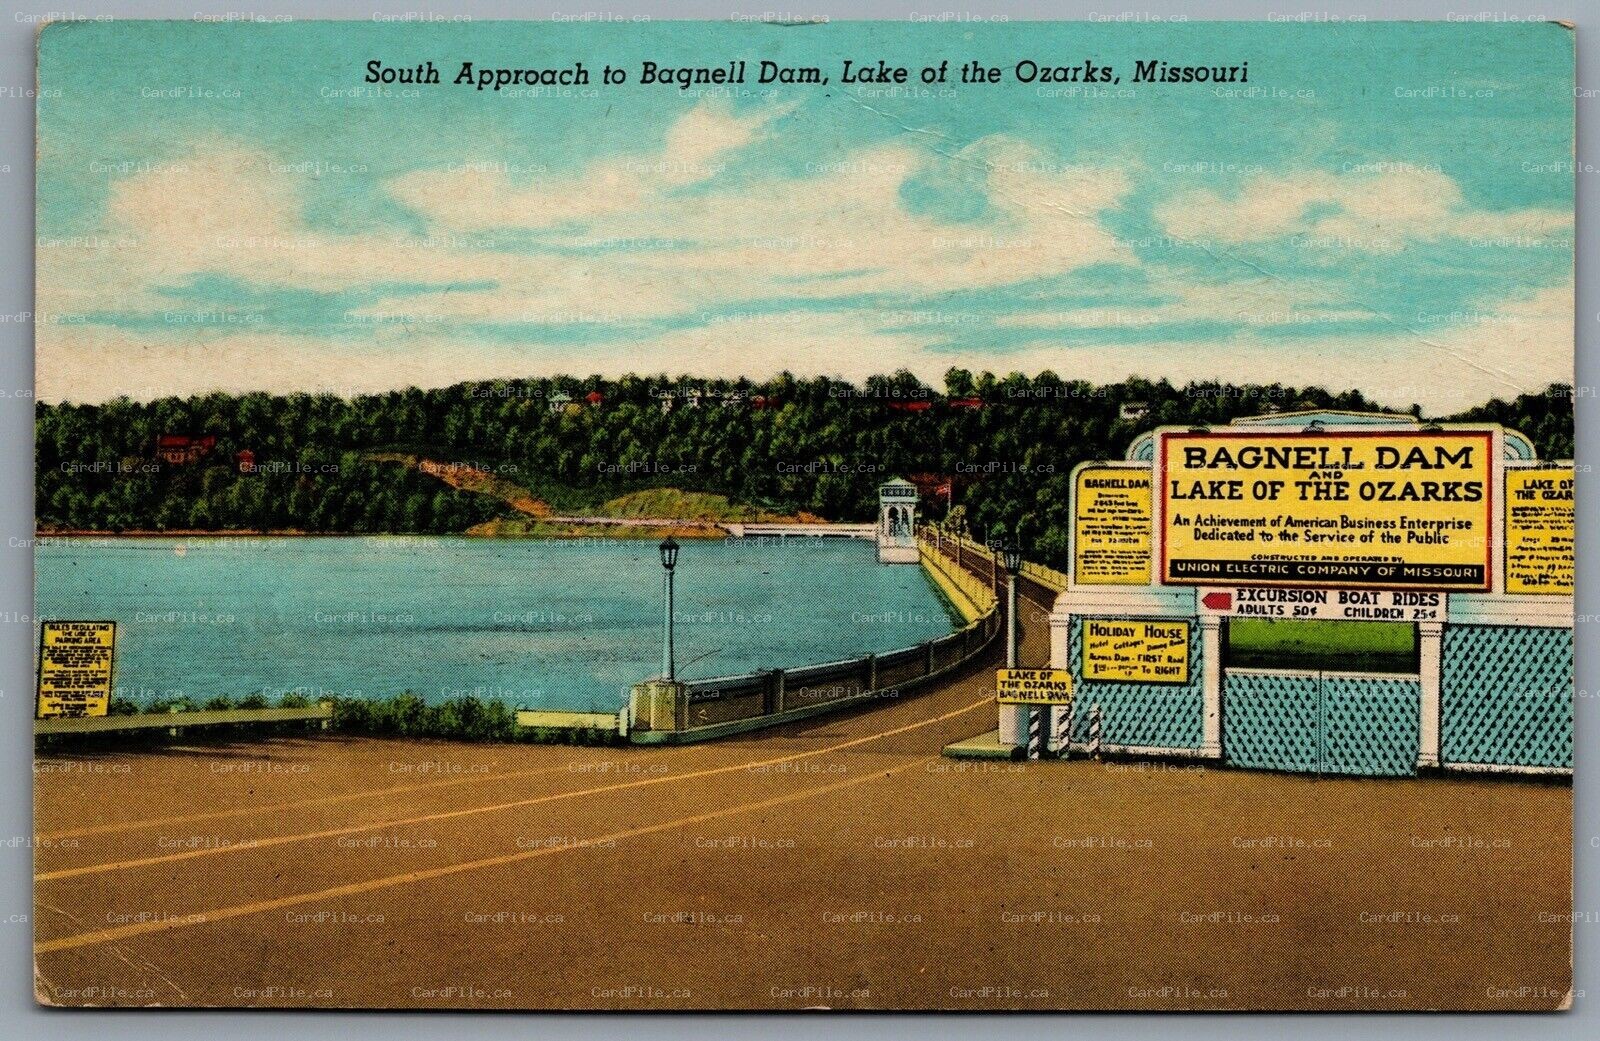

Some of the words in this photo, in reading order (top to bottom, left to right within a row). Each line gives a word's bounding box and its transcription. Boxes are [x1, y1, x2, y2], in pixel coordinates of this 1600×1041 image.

[1184, 447, 1364, 469] BAGNELL
[1375, 447, 1473, 469] DAM
[1309, 471, 1343, 479] AND
[1085, 479, 1127, 488] BAGNELL
[1128, 479, 1150, 489] DAM
[1524, 480, 1554, 489] LAKE
[1171, 481, 1243, 500] LAKE
[1253, 481, 1284, 500] OF
[1295, 481, 1349, 500] THE
[1360, 481, 1482, 501] OZARKS
[1515, 490, 1535, 500] THE
[1173, 514, 1190, 526] An
[1195, 514, 1266, 527] Achievement
[1270, 515, 1282, 527] of
[1284, 516, 1337, 528] American
[1341, 515, 1396, 529] Business
[1400, 516, 1472, 534] Enterprise
[1194, 528, 1254, 541] Dedicated
[1259, 531, 1273, 542] to
[1278, 529, 1298, 541] the
[1304, 529, 1355, 542] Service
[1360, 530, 1374, 543] of
[1381, 531, 1401, 543] the
[1407, 529, 1449, 544] Public
[1250, 554, 1317, 562] CONSTRUCTED
[1178, 563, 1219, 571] UNION
[1227, 564, 1288, 573] ELECTRIC
[1298, 566, 1370, 574] COMPANY
[1378, 567, 1396, 575] OF
[1404, 568, 1476, 577] MISSOURI
[1237, 587, 1328, 604] EXCURSION
[1339, 590, 1382, 604] BOAT
[1392, 591, 1441, 606] RIDES
[1237, 604, 1284, 614] ADULTS
[1293, 606, 1317, 616] 50¢
[1344, 607, 1403, 619] CHILDREN
[1090, 623, 1135, 637] HOLIDAY
[1145, 625, 1183, 639] HOUSE
[1090, 640, 1108, 649] Hotel
[1138, 654, 1162, 663] FIRST
[1142, 665, 1151, 674] To
[1155, 666, 1180, 675] RIGHT
[1008, 671, 1035, 680] LAKE
[1040, 672, 1053, 680] OF
[1024, 681, 1066, 690] OZARKS
